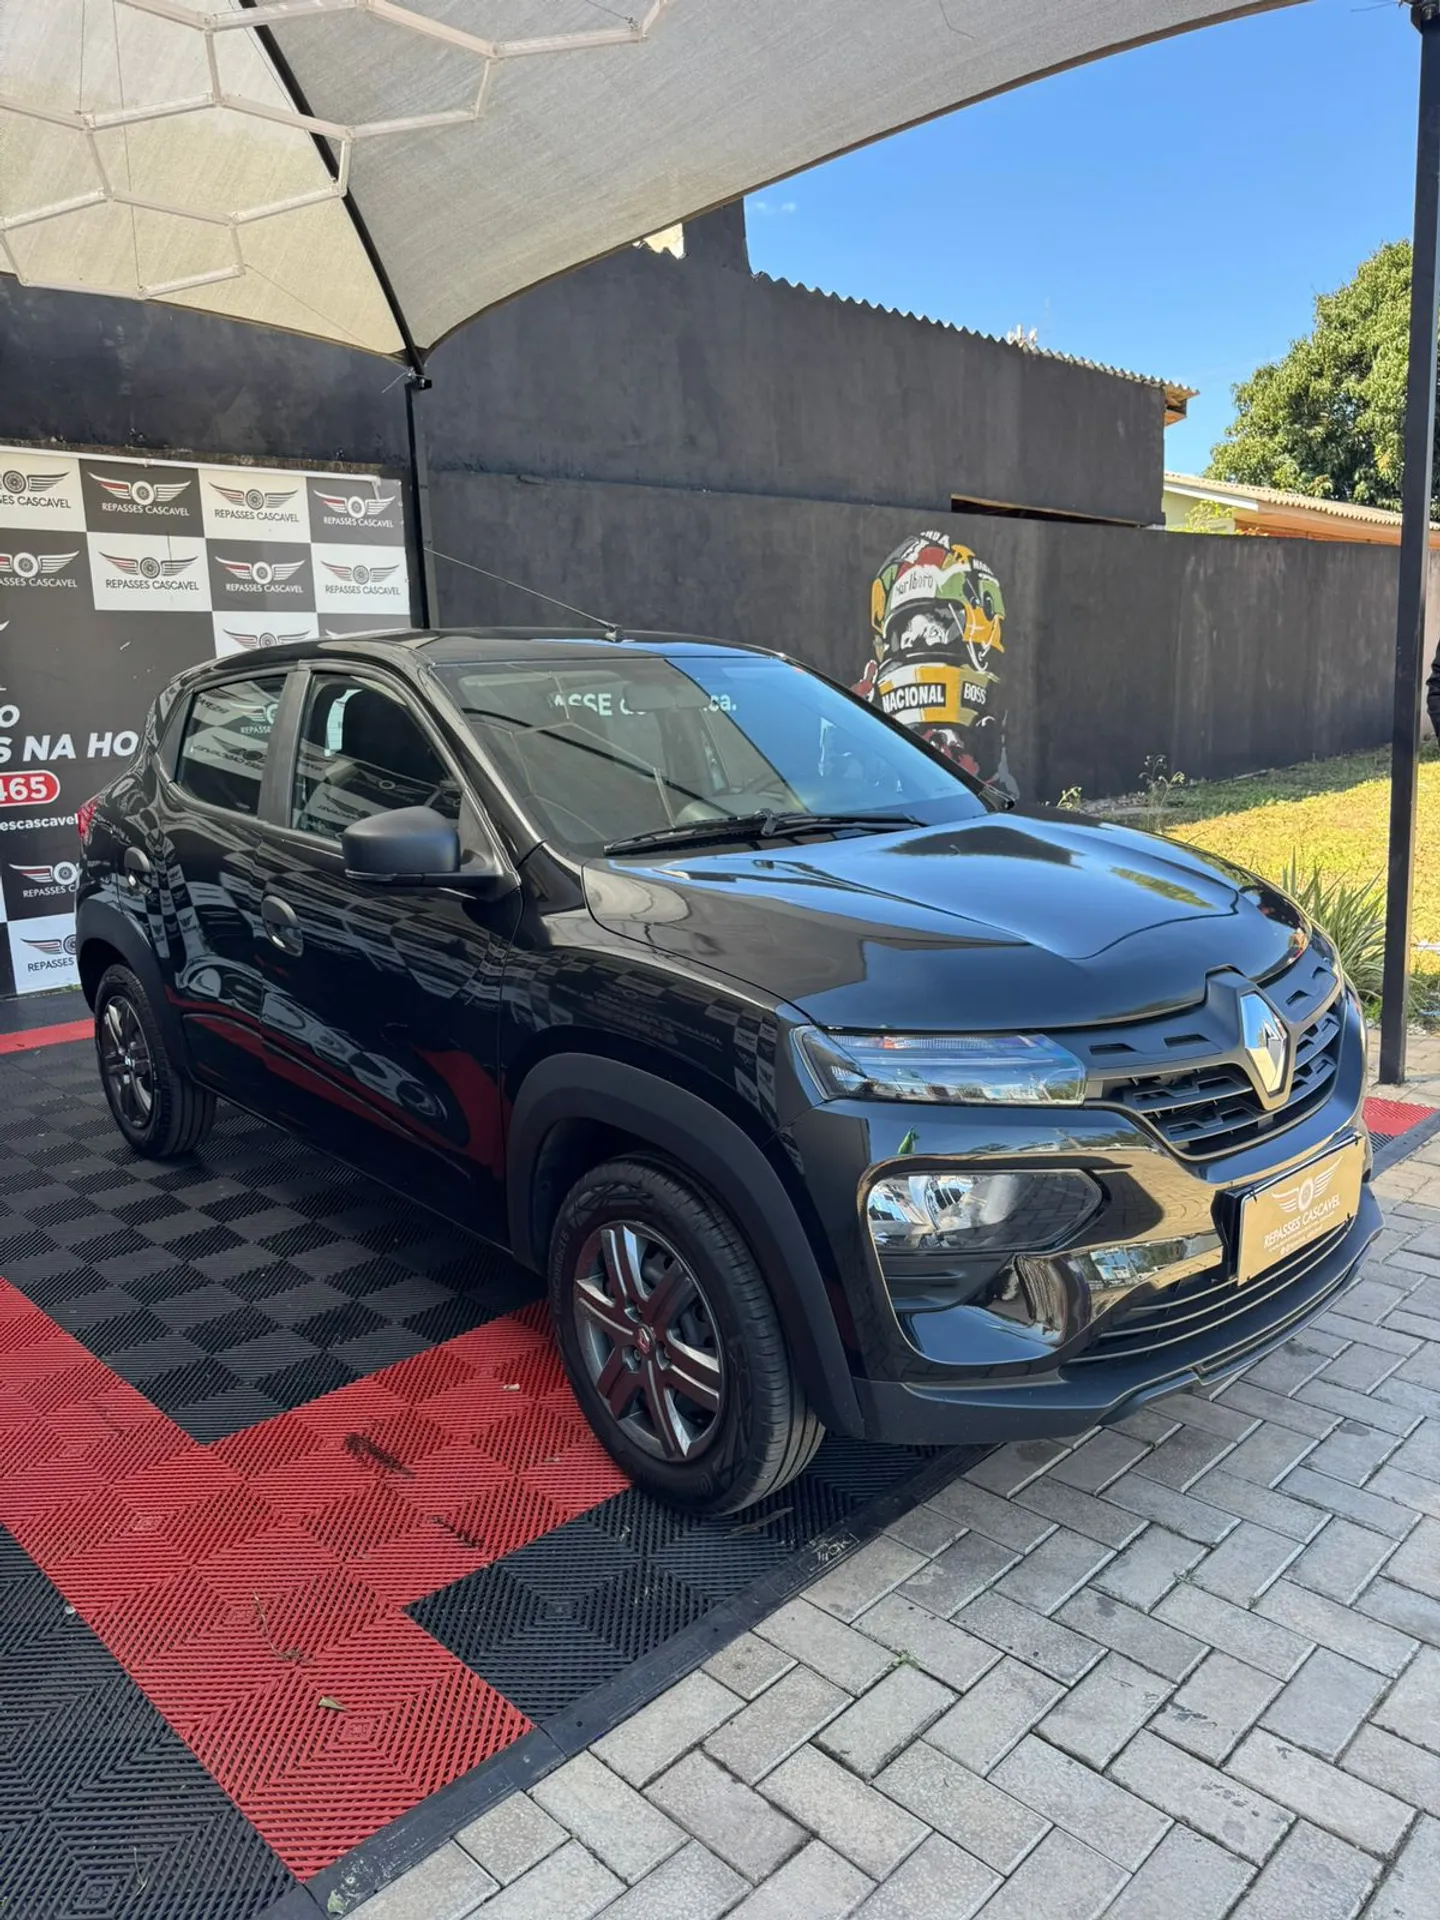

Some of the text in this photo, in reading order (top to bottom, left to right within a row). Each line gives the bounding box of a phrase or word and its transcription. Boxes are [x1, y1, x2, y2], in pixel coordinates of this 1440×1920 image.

[17, 496, 71, 509] CASCAVEL
[102, 502, 190, 516] REPASSES CASCAVEL
[214, 509, 300, 522] REPASSES CASCAVEL
[323, 516, 394, 528] REPASSES CASCAVEL
[28, 577, 78, 588] CASCAVEL
[105, 579, 200, 591] REPASSES CASCAVEL
[226, 583, 303, 594] REPASSES CASCAVEL
[325, 584, 400, 596] REPASSES CASCAVEL
[882, 685, 944, 713] NACIONAL
[963, 682, 986, 705] BOSS
[23, 734, 76, 762] NA
[87, 731, 139, 758] HO
[23, 885, 66, 898] REPASSES
[27, 958, 75, 972] REPASSES
[1264, 1216, 1301, 1249] REPASSES
[1302, 1193, 1340, 1226] CASCAVEL
